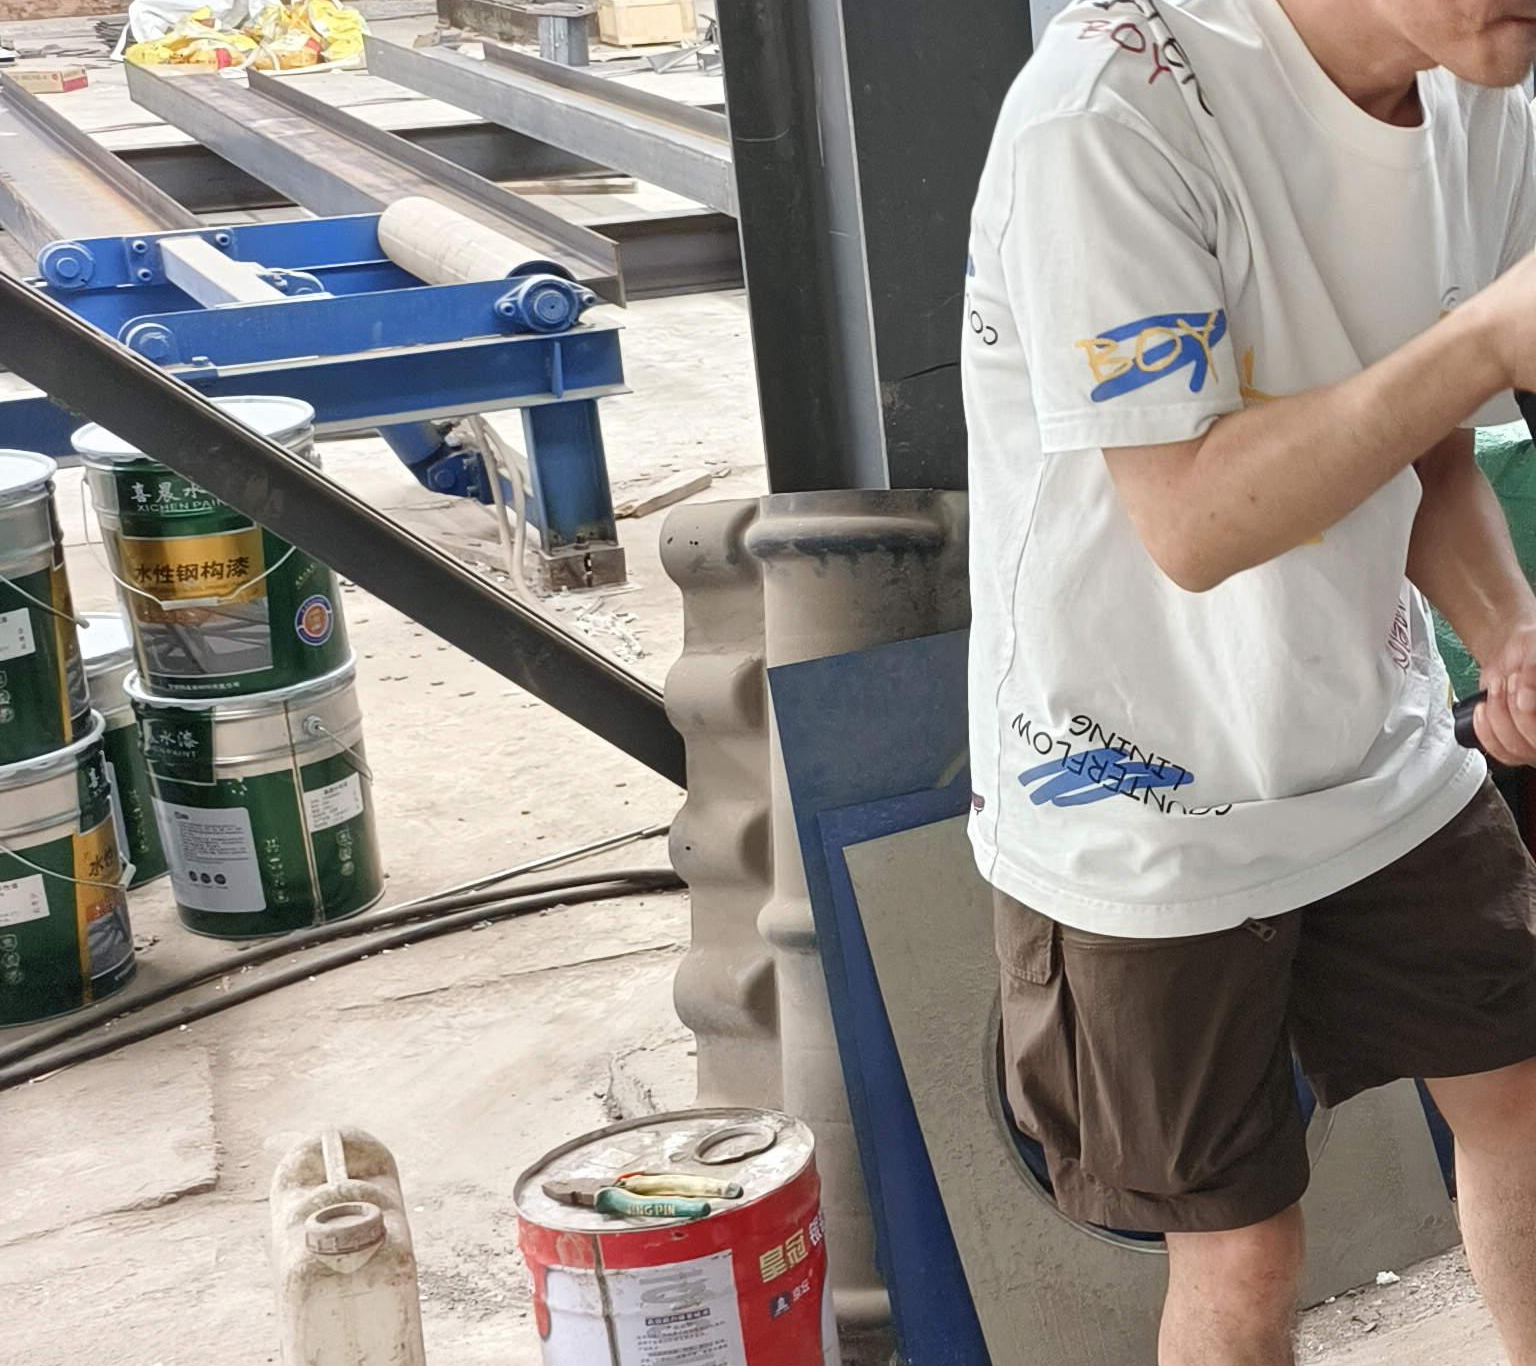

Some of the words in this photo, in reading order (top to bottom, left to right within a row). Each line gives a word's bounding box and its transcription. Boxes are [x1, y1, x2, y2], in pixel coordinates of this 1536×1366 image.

[1075, 309, 1219, 388] BOY
[137, 500, 189, 512] XICHEN
[134, 555, 250, 585] 水性钢构漆
[759, 1227, 808, 1284] 皇冠
